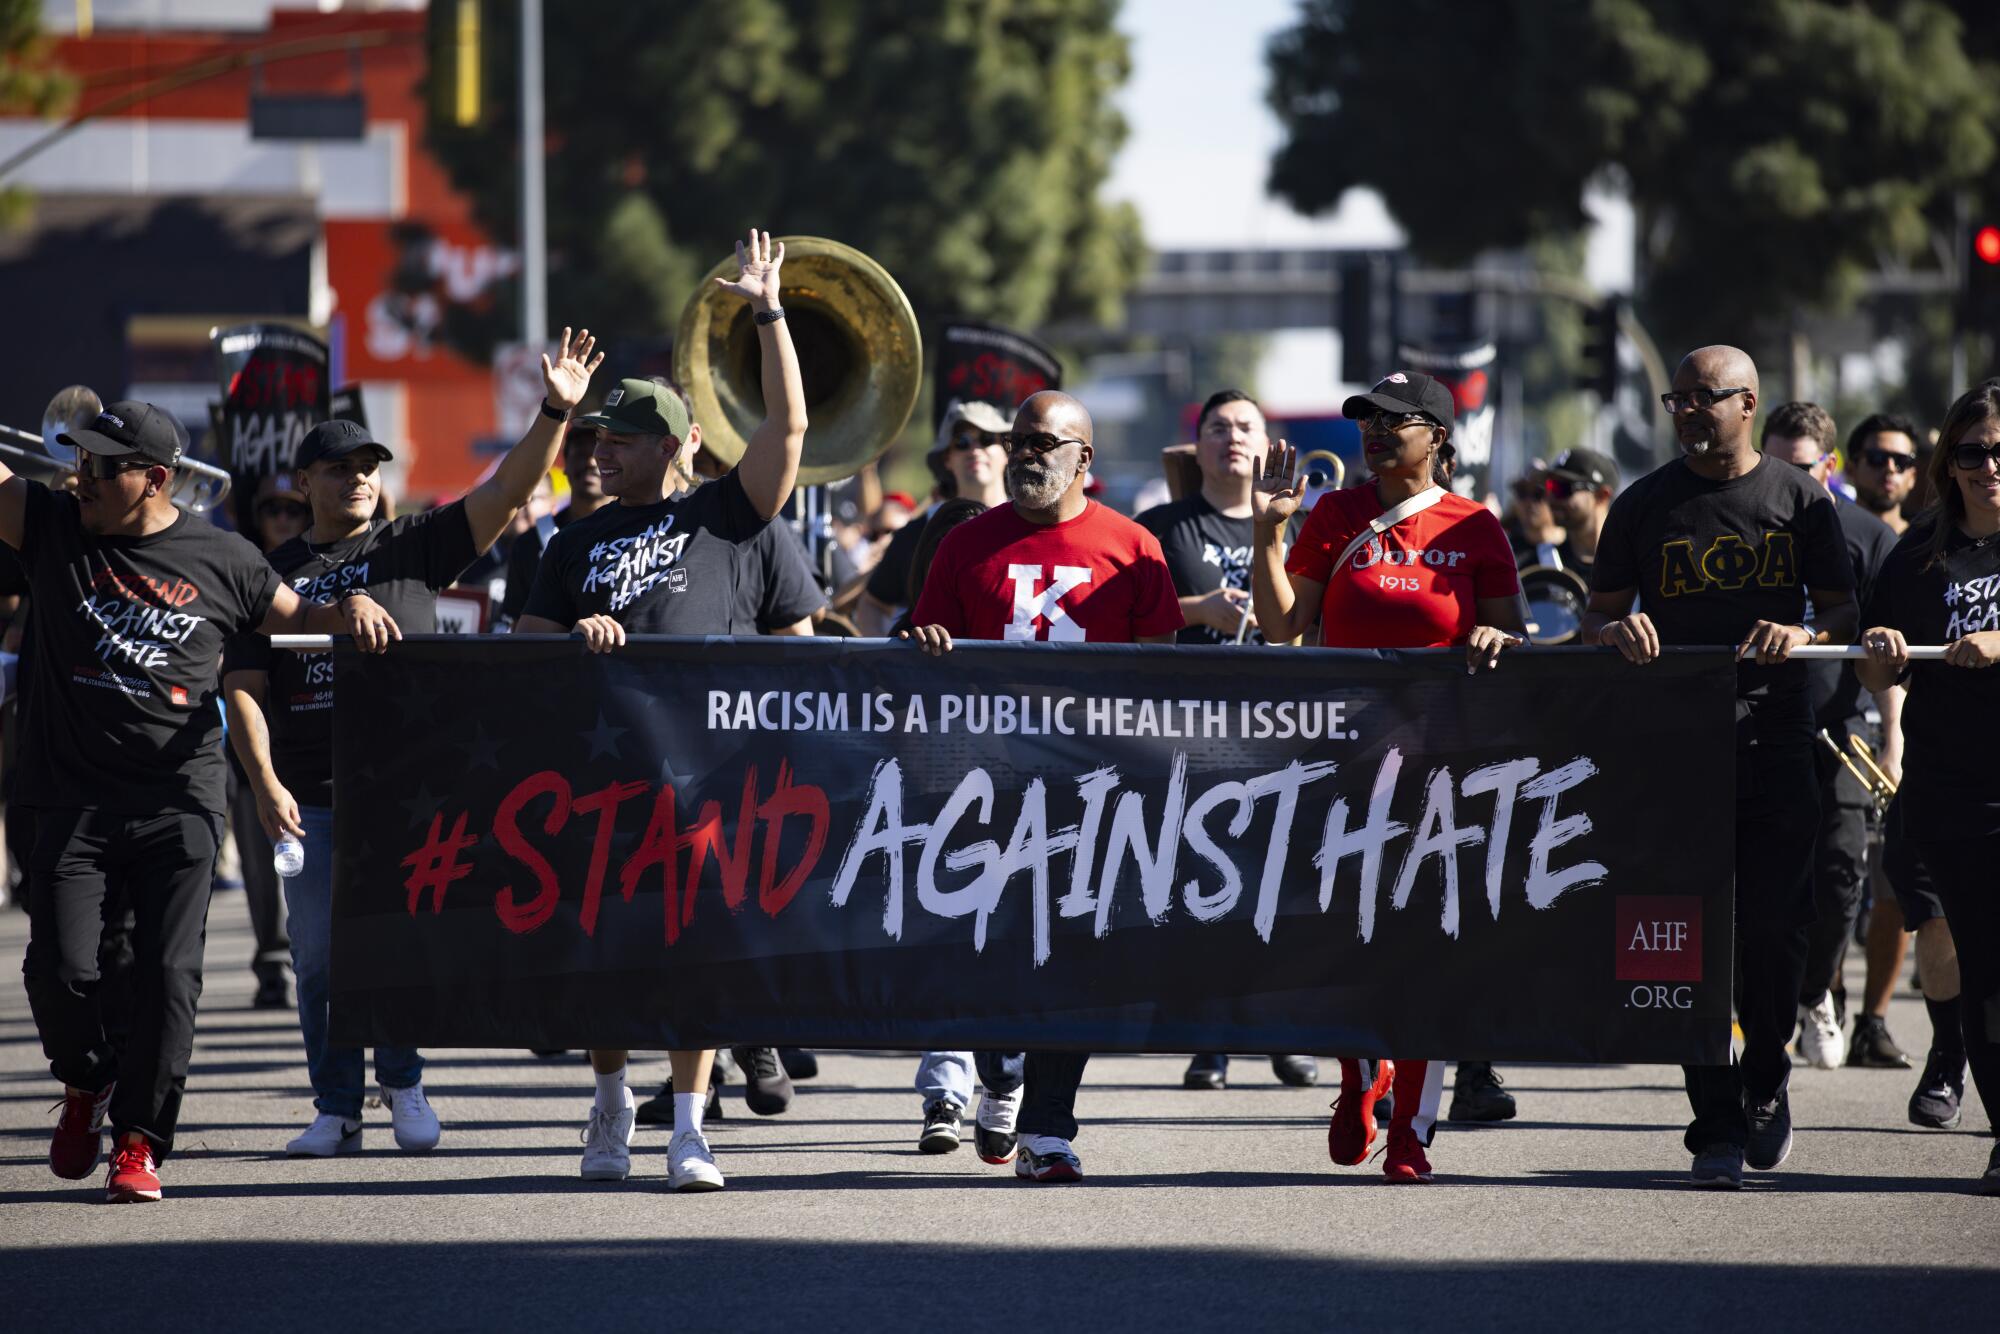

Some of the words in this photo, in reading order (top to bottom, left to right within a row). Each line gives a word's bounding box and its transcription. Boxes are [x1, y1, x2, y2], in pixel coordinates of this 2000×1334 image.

[231, 410, 313, 476] AGAIN
[294, 562, 370, 594] RACSM
[582, 534, 690, 593] AGAINST
[1379, 575, 1420, 591] 1913
[1944, 574, 2000, 606] #ST
[1004, 564, 1092, 641] K
[76, 595, 207, 644] AGAINST
[94, 633, 168, 667] HATE
[306, 662, 333, 684] ISS
[707, 690, 849, 731] RACISM
[862, 693, 895, 732] IS
[904, 694, 928, 733] A
[940, 694, 1075, 735] PUBLIC
[1086, 697, 1226, 738] HEALTH
[1240, 700, 1359, 740] ISSUE.
[1628, 921, 1687, 951] AHF
[1624, 986, 1693, 1009] .ORG
